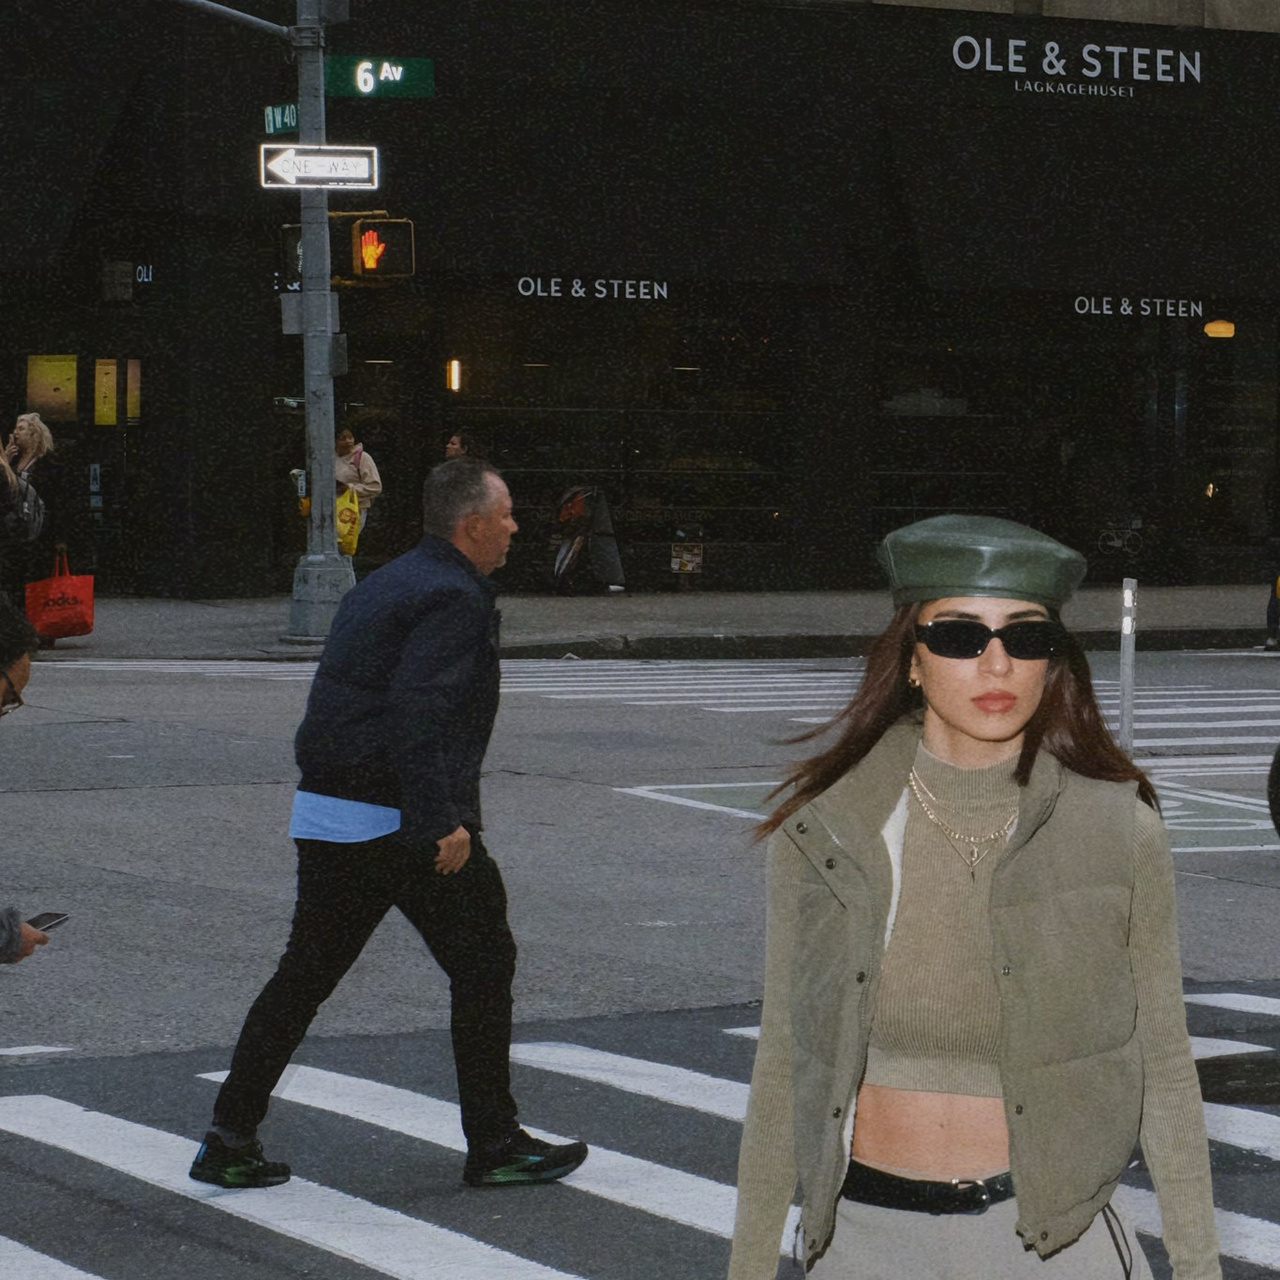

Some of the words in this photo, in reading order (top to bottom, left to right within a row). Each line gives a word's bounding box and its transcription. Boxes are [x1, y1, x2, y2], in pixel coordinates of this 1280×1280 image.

[952, 35, 1027, 73] OLE
[1042, 41, 1067, 76] &
[1081, 43, 1201, 84] STEEN
[356, 61, 374, 93] 6
[379, 62, 404, 81] Av
[1014, 79, 1136, 98] LAGKAGEHUSET
[274, 106, 282, 129] W
[283, 104, 297, 127] 40
[282, 159, 311, 174] ONE
[329, 160, 360, 174] WAY
[517, 276, 563, 297] OLE
[571, 278, 587, 298] &
[594, 279, 668, 300] STEEN
[1074, 296, 1113, 315] OLE
[1120, 297, 1133, 316] &
[1140, 298, 1203, 318] STEEN
